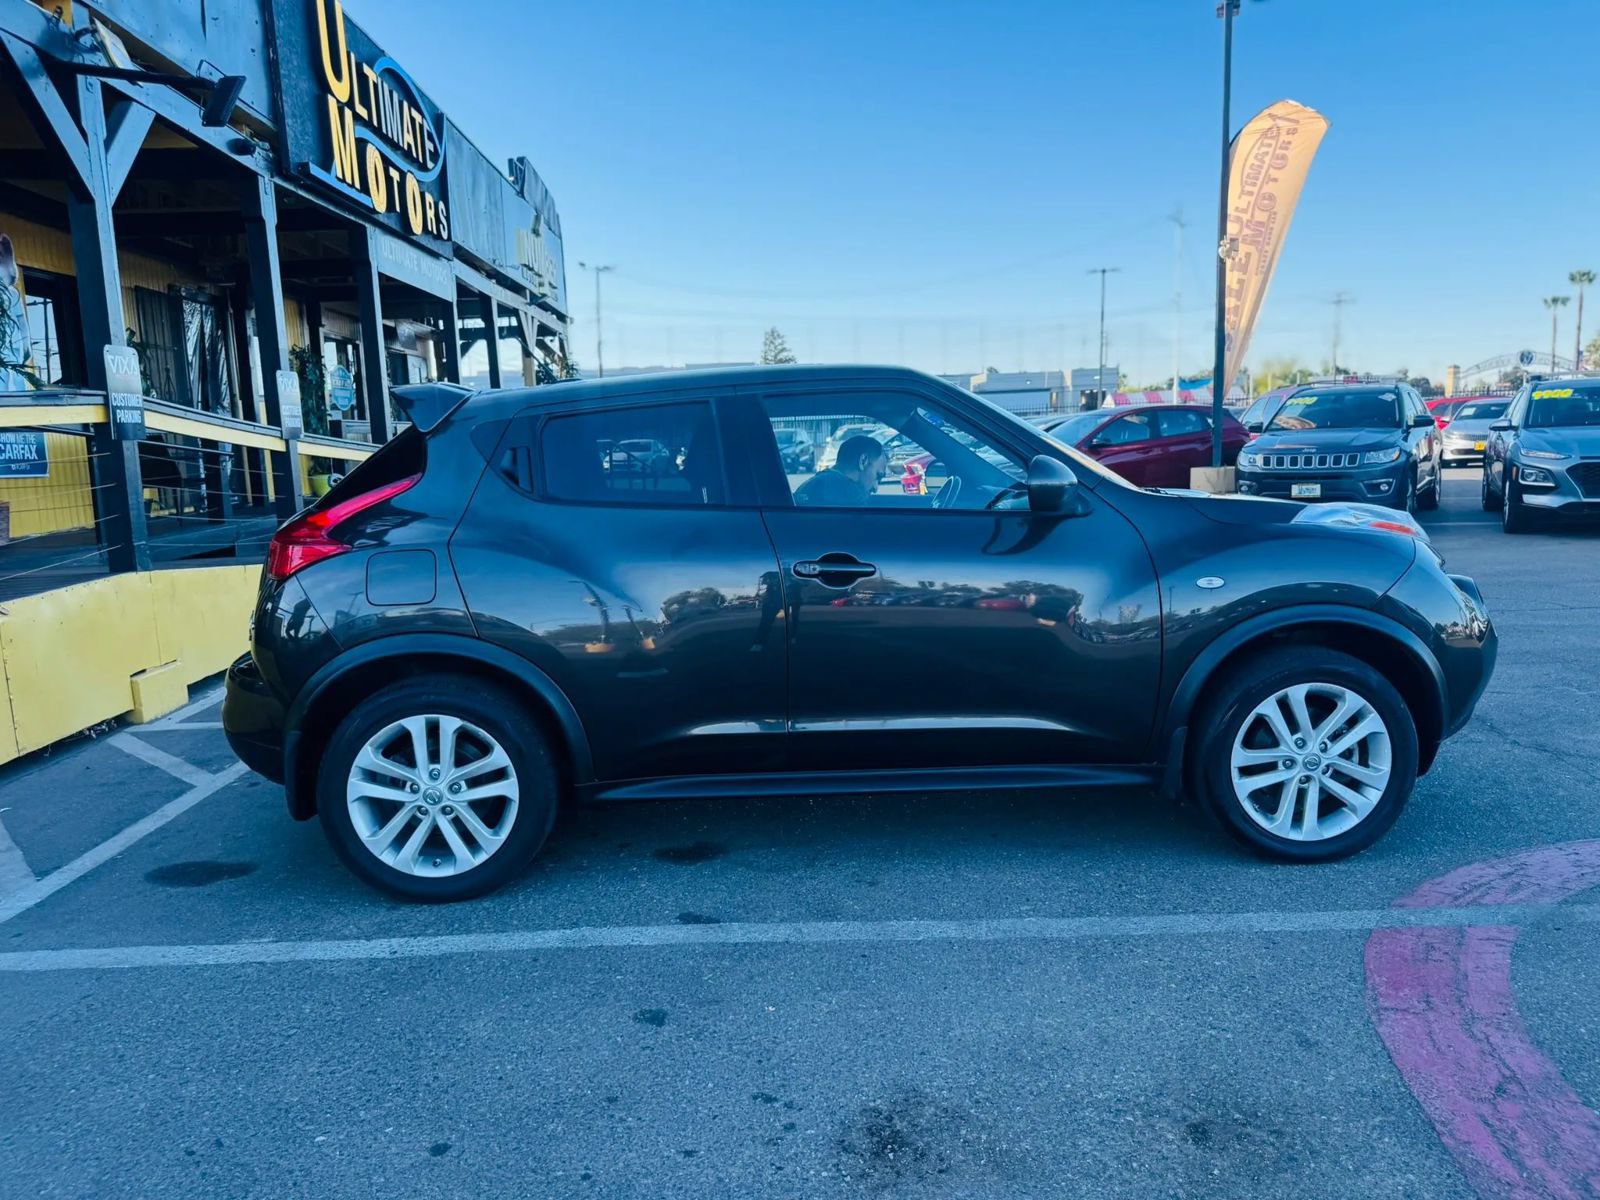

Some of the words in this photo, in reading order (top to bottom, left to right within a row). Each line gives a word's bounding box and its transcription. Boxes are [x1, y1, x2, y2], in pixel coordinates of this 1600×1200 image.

[317, 0, 435, 170] ULTIMATE
[327, 93, 449, 241] MOTORS
[1228, 123, 1281, 239] ULTIMATE
[1241, 127, 1300, 249] MOTORS
[111, 392, 143, 408] CUSTOMER
[116, 409, 142, 424] PARKING
[0, 432, 15, 443] HOW
[0, 443, 39, 460] CARFAX
